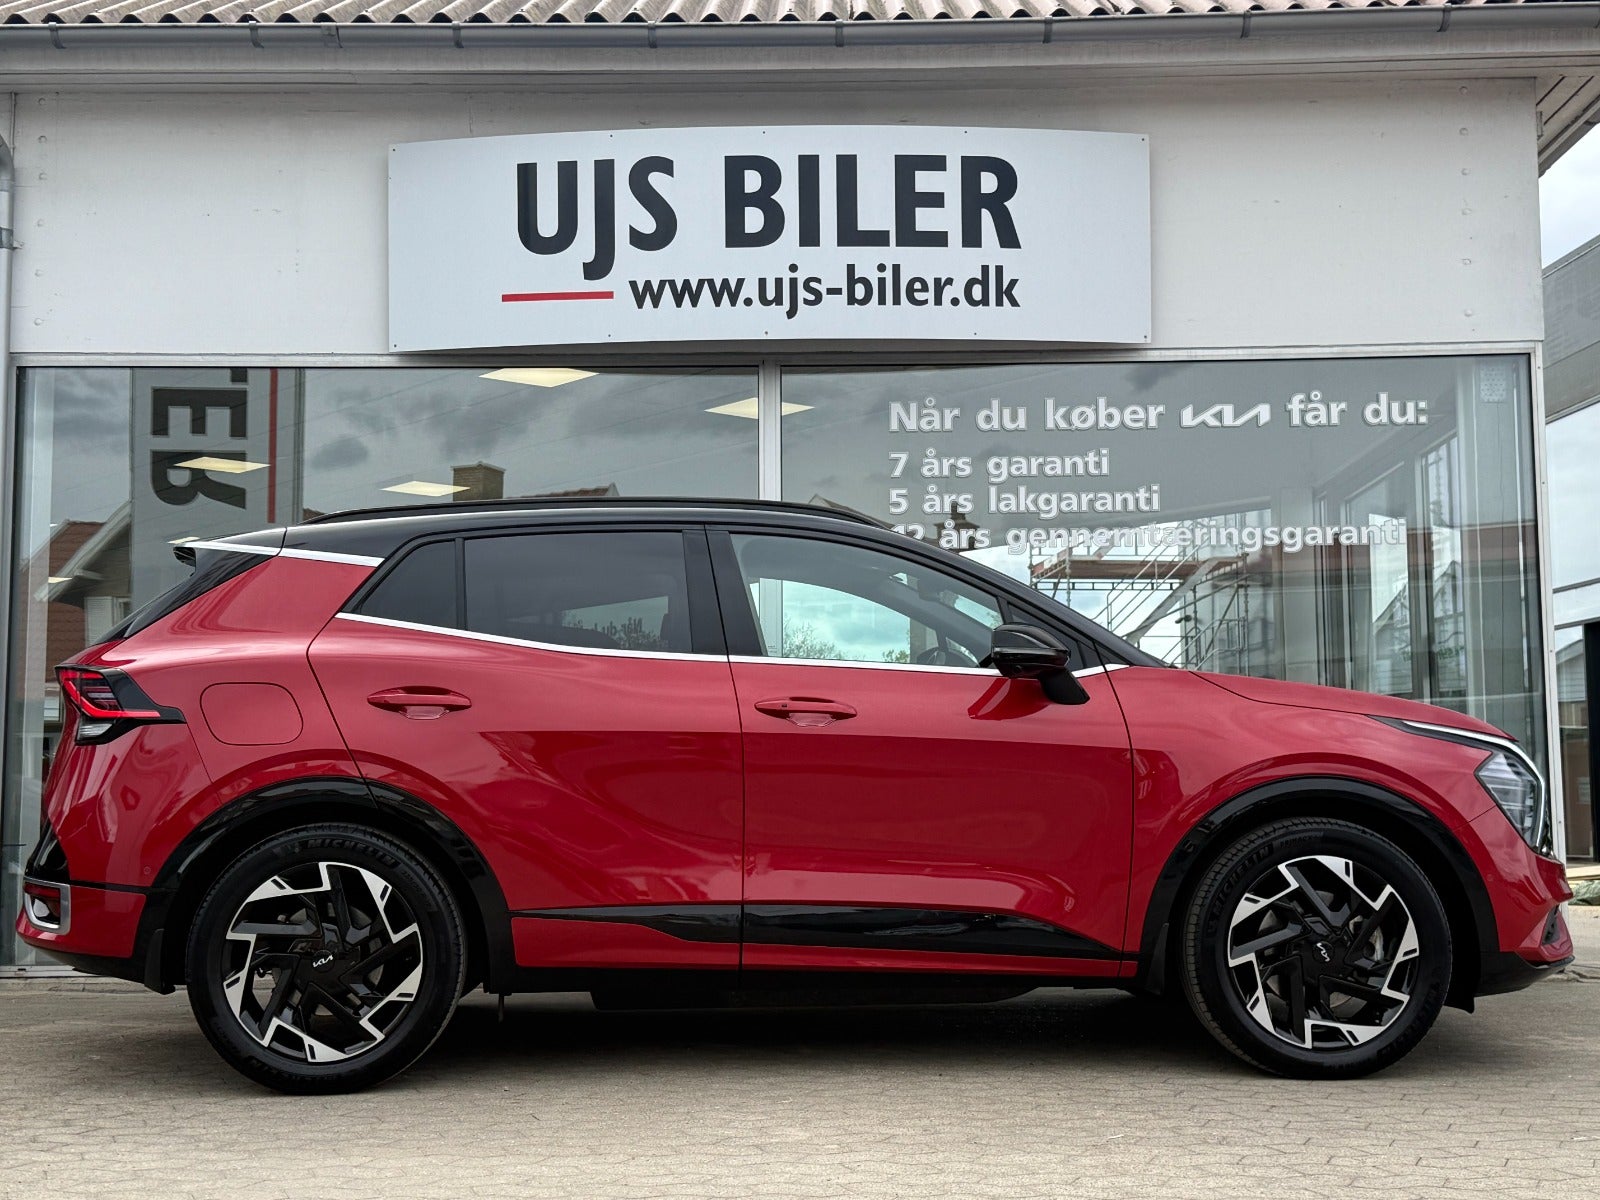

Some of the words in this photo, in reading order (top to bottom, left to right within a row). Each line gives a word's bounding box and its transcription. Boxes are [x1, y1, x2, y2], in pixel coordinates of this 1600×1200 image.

[515, 155, 678, 280] UJS
[724, 153, 1022, 249] BILER
[628, 263, 1021, 319] www.ujs-biler.dk
[888, 397, 961, 432] Når
[975, 397, 1028, 431] du
[1044, 396, 1165, 431] køber
[1286, 390, 1347, 427] får
[1362, 391, 1429, 427] du:
[888, 451, 909, 478] 7
[920, 447, 972, 478] års
[986, 447, 1110, 484] garanti
[888, 487, 909, 515] 5
[922, 483, 975, 514] års
[987, 483, 1160, 520] lakgaranti
[938, 518, 991, 549] års
[1005, 517, 1408, 554] gennemtæringsgaranti
[306, 837, 398, 869] MICHELIN
